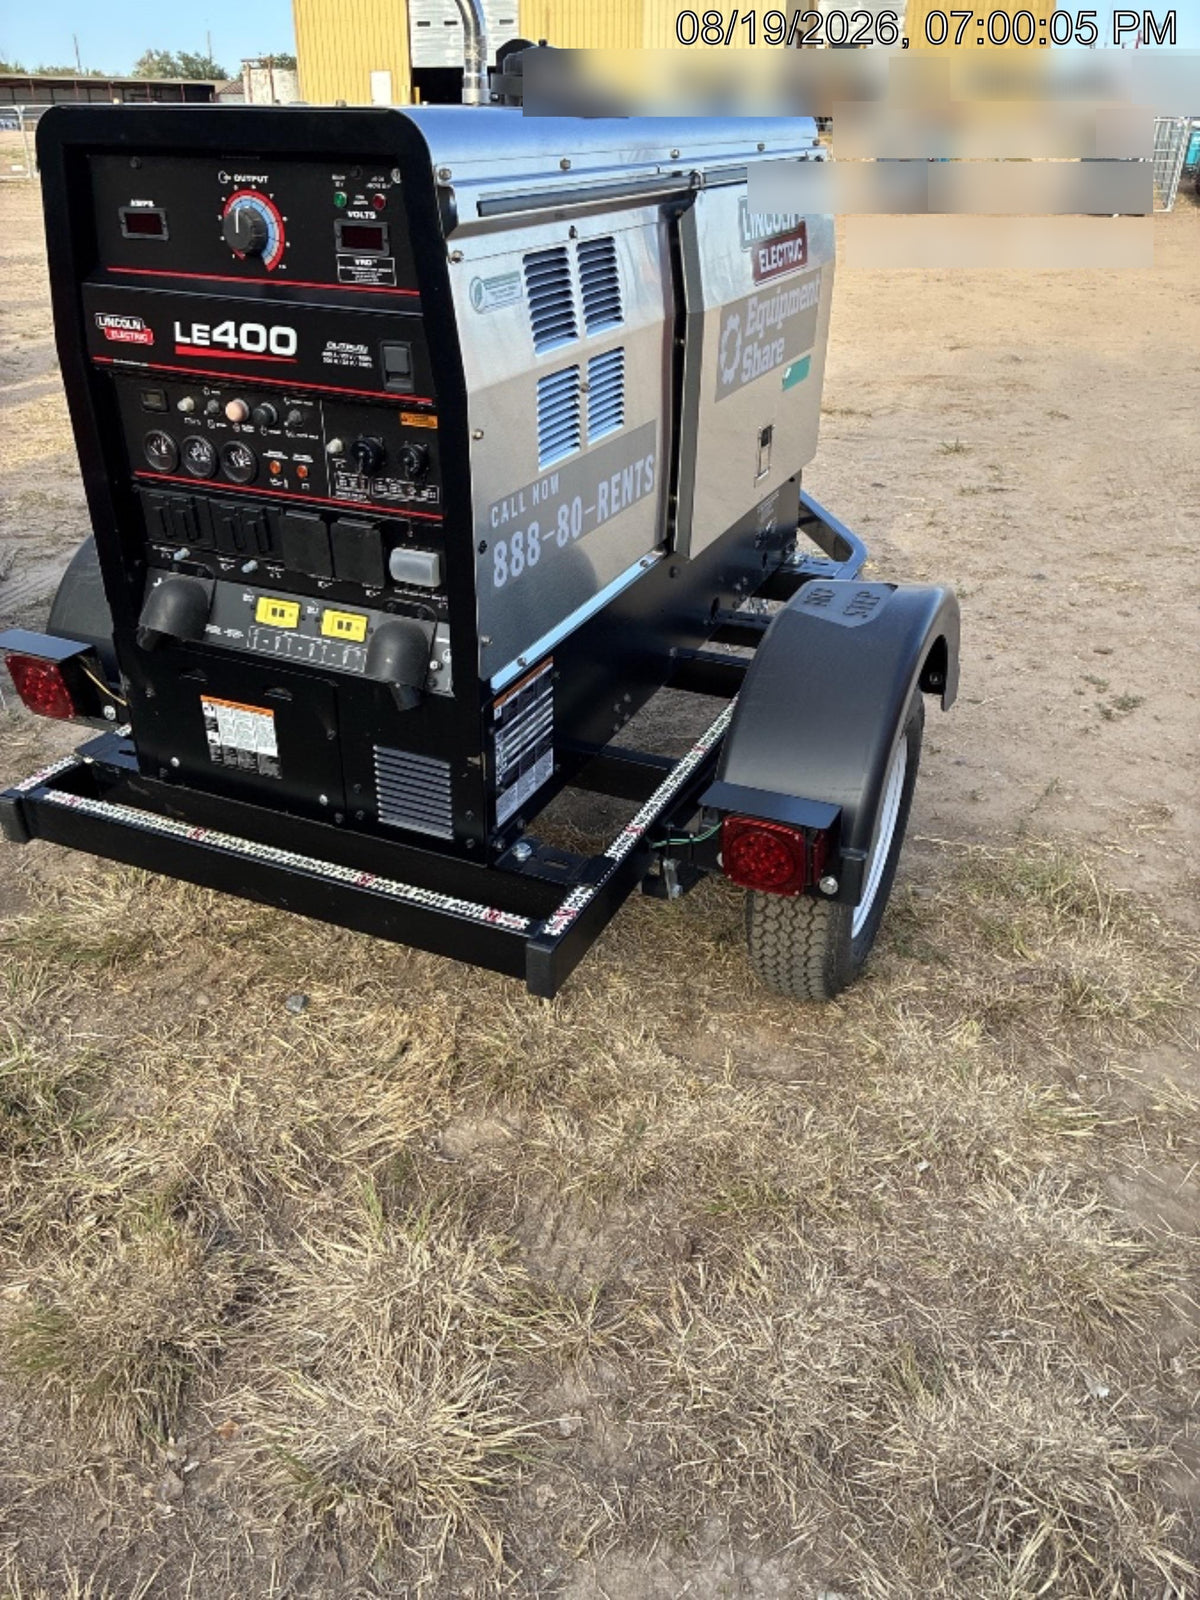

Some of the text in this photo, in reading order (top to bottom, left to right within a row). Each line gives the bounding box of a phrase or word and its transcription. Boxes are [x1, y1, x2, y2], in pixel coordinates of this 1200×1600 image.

[347, 210, 377, 220] VOLTS
[758, 237, 803, 274] ELECTRIC
[98, 315, 142, 332] LINCOLN
[745, 273, 821, 339] Equipment
[173, 320, 298, 356] LE400
[741, 336, 785, 384] Share
[491, 472, 560, 529] CALL NOW
[493, 453, 655, 588] 888-80-RENTS
